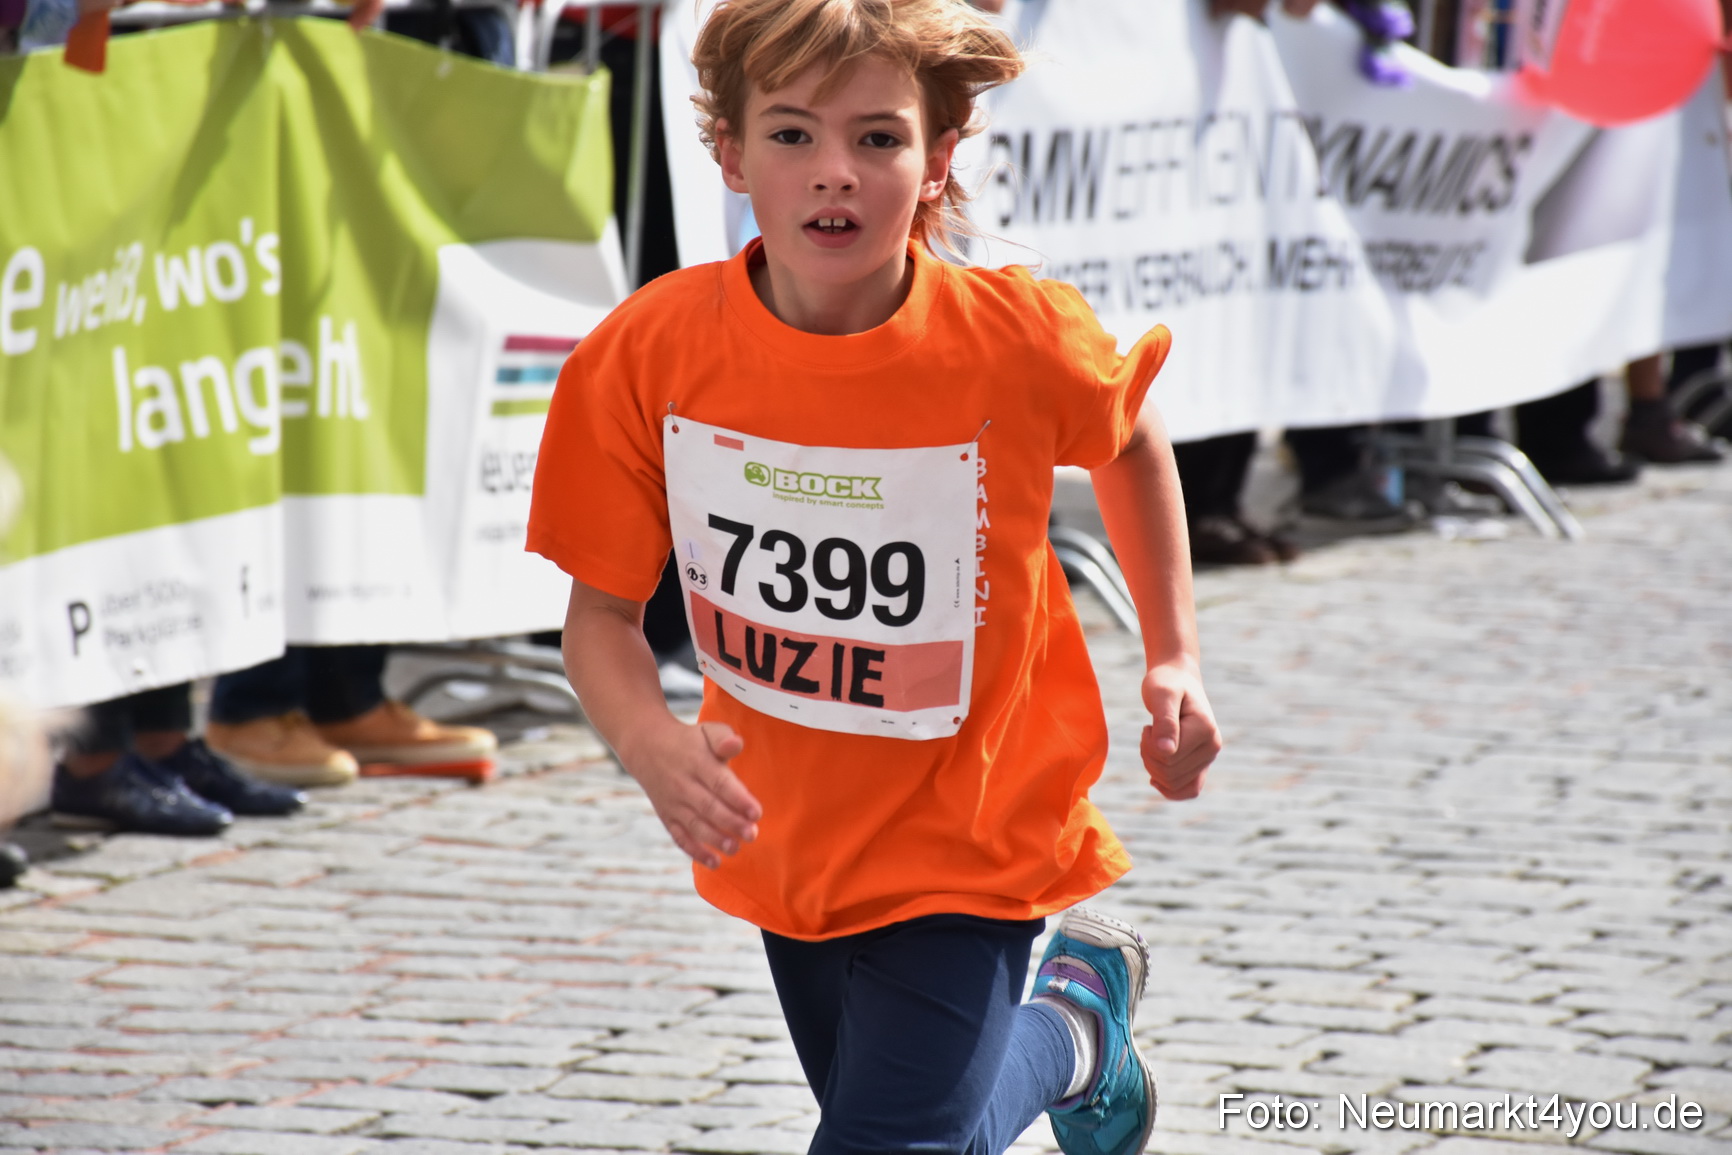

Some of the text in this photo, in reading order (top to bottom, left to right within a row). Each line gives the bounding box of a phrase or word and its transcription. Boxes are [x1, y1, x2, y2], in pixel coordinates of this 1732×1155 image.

[154, 217, 281, 311] wo's
[772, 492, 885, 510] inspired by smart concepts
[774, 467, 883, 500] BOCK
[708, 513, 926, 627] 7399
[714, 609, 886, 707] LUZIE
